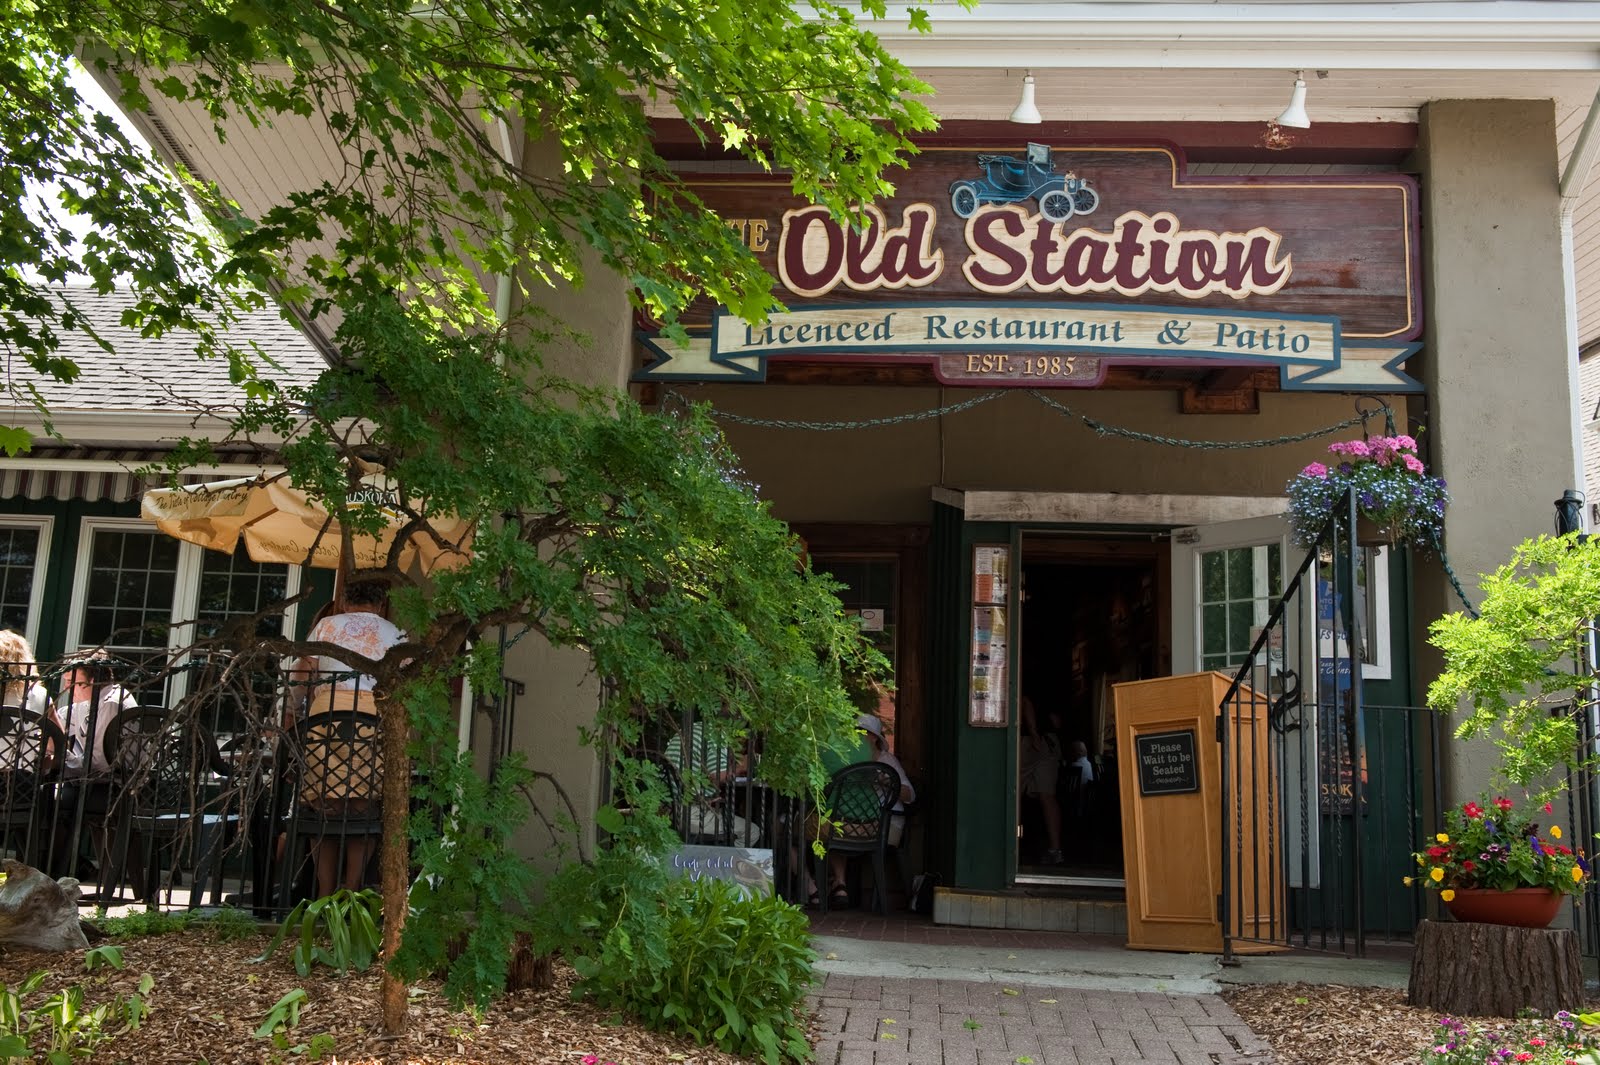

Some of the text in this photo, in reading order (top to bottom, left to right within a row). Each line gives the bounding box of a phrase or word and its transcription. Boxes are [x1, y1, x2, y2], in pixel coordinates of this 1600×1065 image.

[778, 203, 943, 297] Old
[963, 204, 1292, 299] Station
[742, 313, 1310, 353] Licenced Restaurant & Patio
[966, 354, 1076, 376] EST. 1985
[346, 490, 398, 506] USKOKA
[1150, 743, 1182, 754] Please
[1143, 753, 1191, 765] Wait to be
[1153, 765, 1185, 776] Seated
